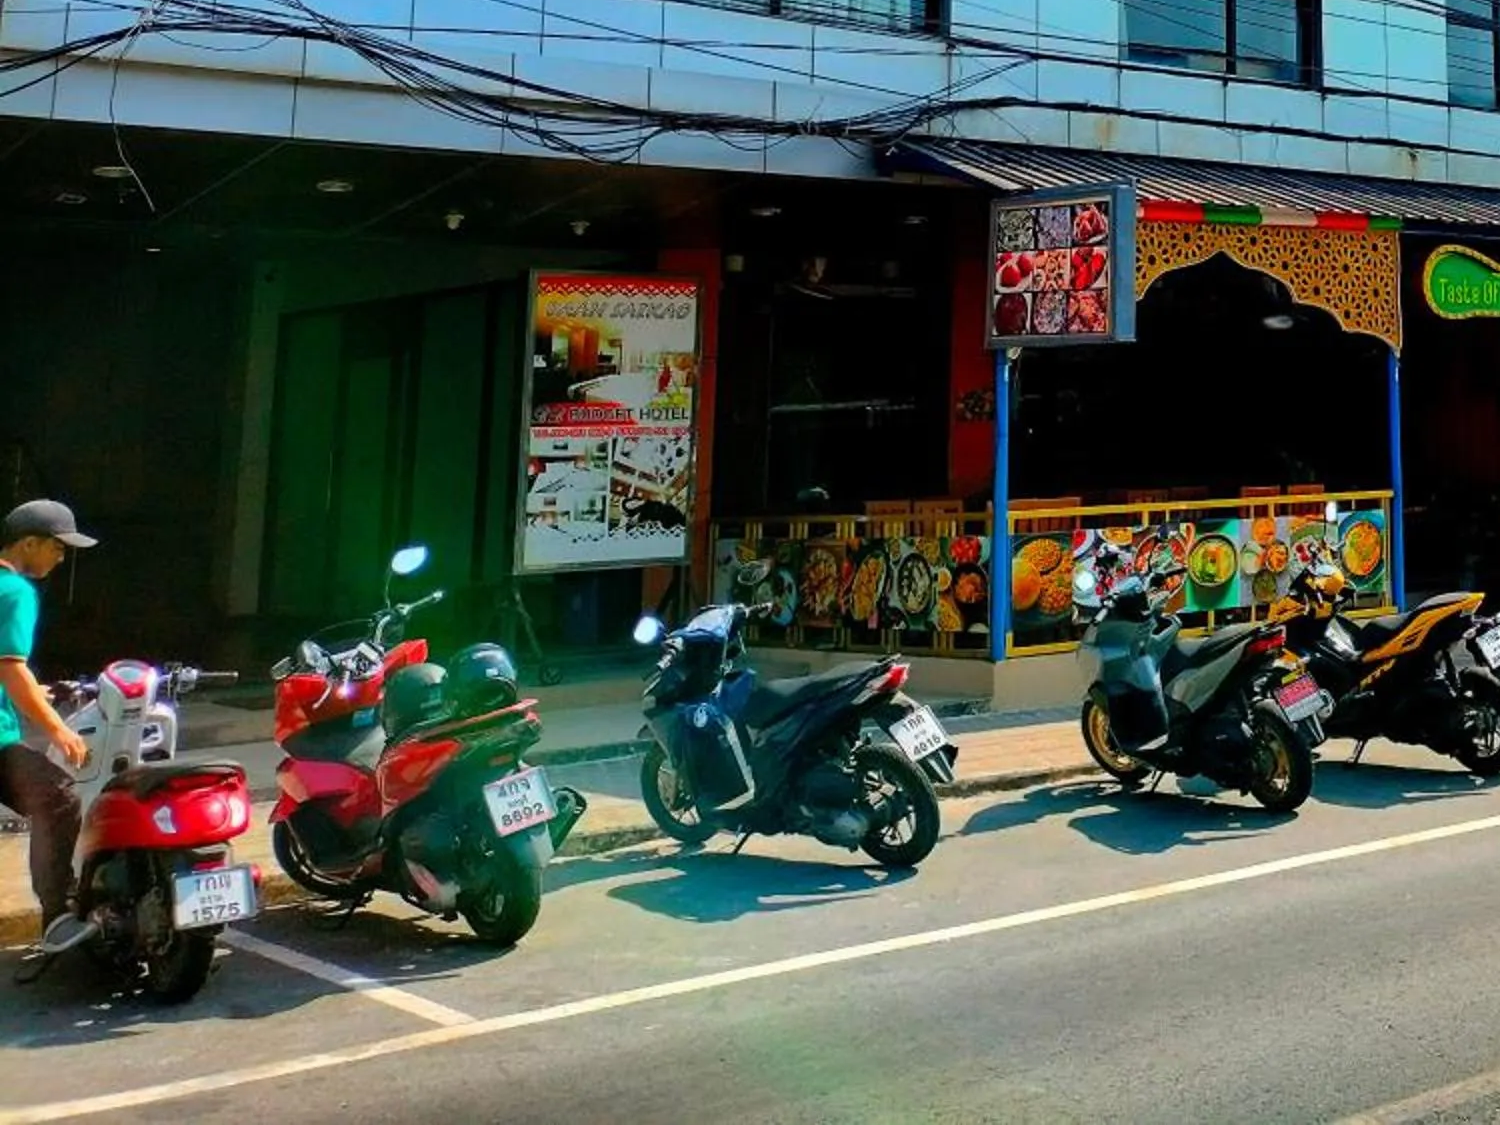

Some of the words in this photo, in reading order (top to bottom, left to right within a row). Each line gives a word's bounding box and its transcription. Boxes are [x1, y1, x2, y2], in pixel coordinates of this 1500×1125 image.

[1439, 277, 1480, 305] Taste
[639, 407, 689, 421] HOTEL
[191, 902, 241, 922] 1575
